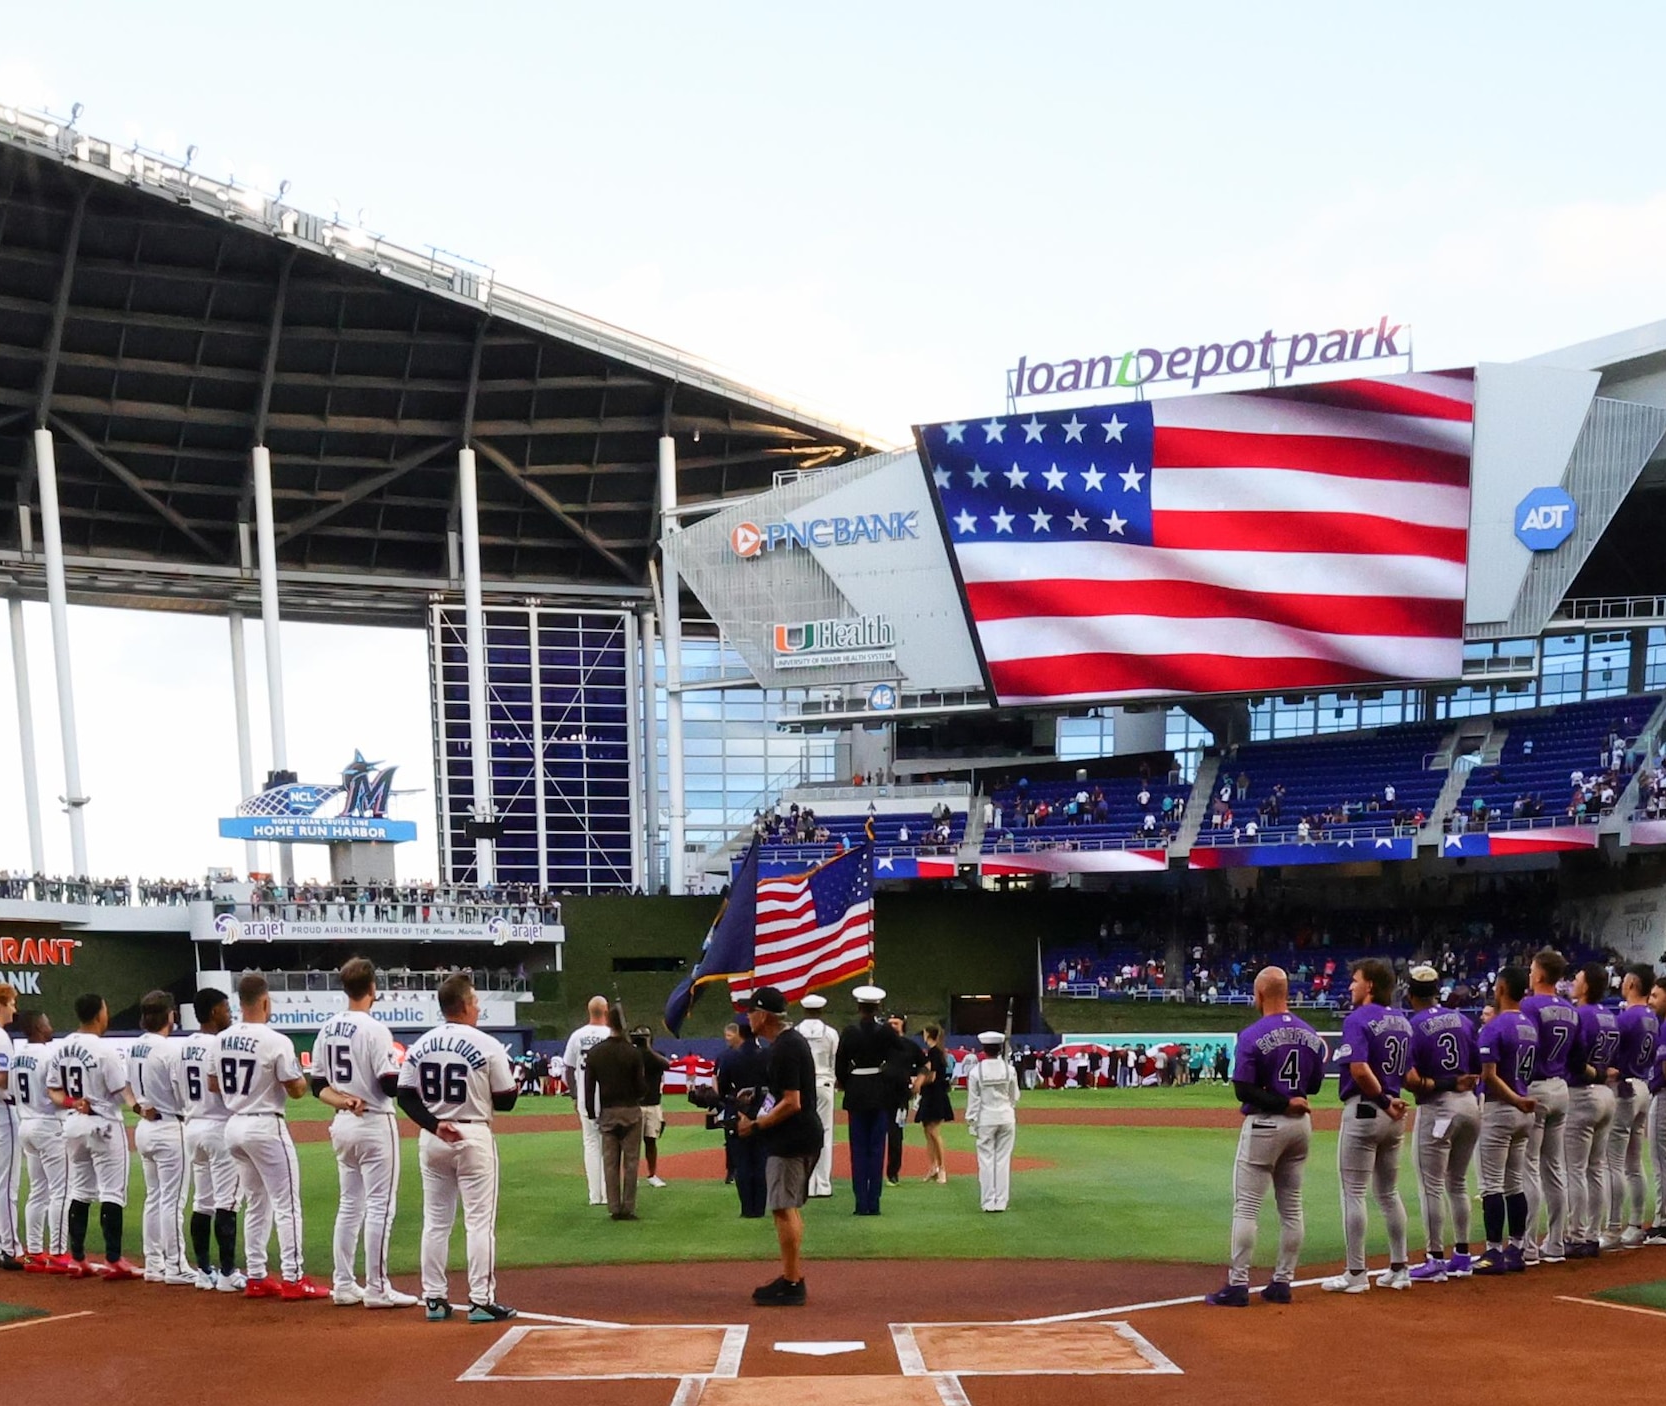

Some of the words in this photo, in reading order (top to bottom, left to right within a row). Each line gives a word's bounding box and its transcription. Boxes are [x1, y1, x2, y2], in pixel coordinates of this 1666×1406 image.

[1015, 329, 1277, 398] loanDepot
[1284, 315, 1404, 379] park
[1520, 504, 1570, 531] ADT
[775, 657, 811, 668] UNIVERSITY
[821, 655, 842, 665] MIAMI
[843, 653, 866, 663] HEALTH
[867, 652, 893, 662] SYSTEM
[872, 688, 892, 706] 42
[290, 790, 315, 804] NCL
[253, 825, 294, 838] HOME
[299, 825, 328, 838] RUN
[333, 826, 386, 839] HARBOR
[271, 818, 320, 826] NORWEGIAN
[322, 818, 350, 826] CRUISE
[352, 819, 369, 827] LINE
[244, 920, 285, 943] arajet
[291, 926, 321, 935] PROUD
[361, 926, 400, 935] PARTNER
[402, 926, 414, 935] OF
[417, 926, 430, 935] THE
[511, 918, 543, 943] arajet
[221, 1037, 260, 1053] MARSEE
[324, 1022, 357, 1040] SLATER
[1546, 1026, 1568, 1061] 7
[1588, 1030, 1621, 1064] 27
[326, 1044, 353, 1083] 15
[407, 1036, 487, 1071] McCULLOUGH
[1382, 1035, 1409, 1076] 31
[1437, 1033, 1459, 1070] 3
[1637, 1033, 1653, 1065] 9
[60, 1065, 82, 1099] 13
[187, 1066, 202, 1100] 6
[221, 1058, 256, 1096] 87
[419, 1062, 468, 1104] 86
[1279, 1049, 1300, 1090] 4
[18, 1072, 30, 1103] 9
